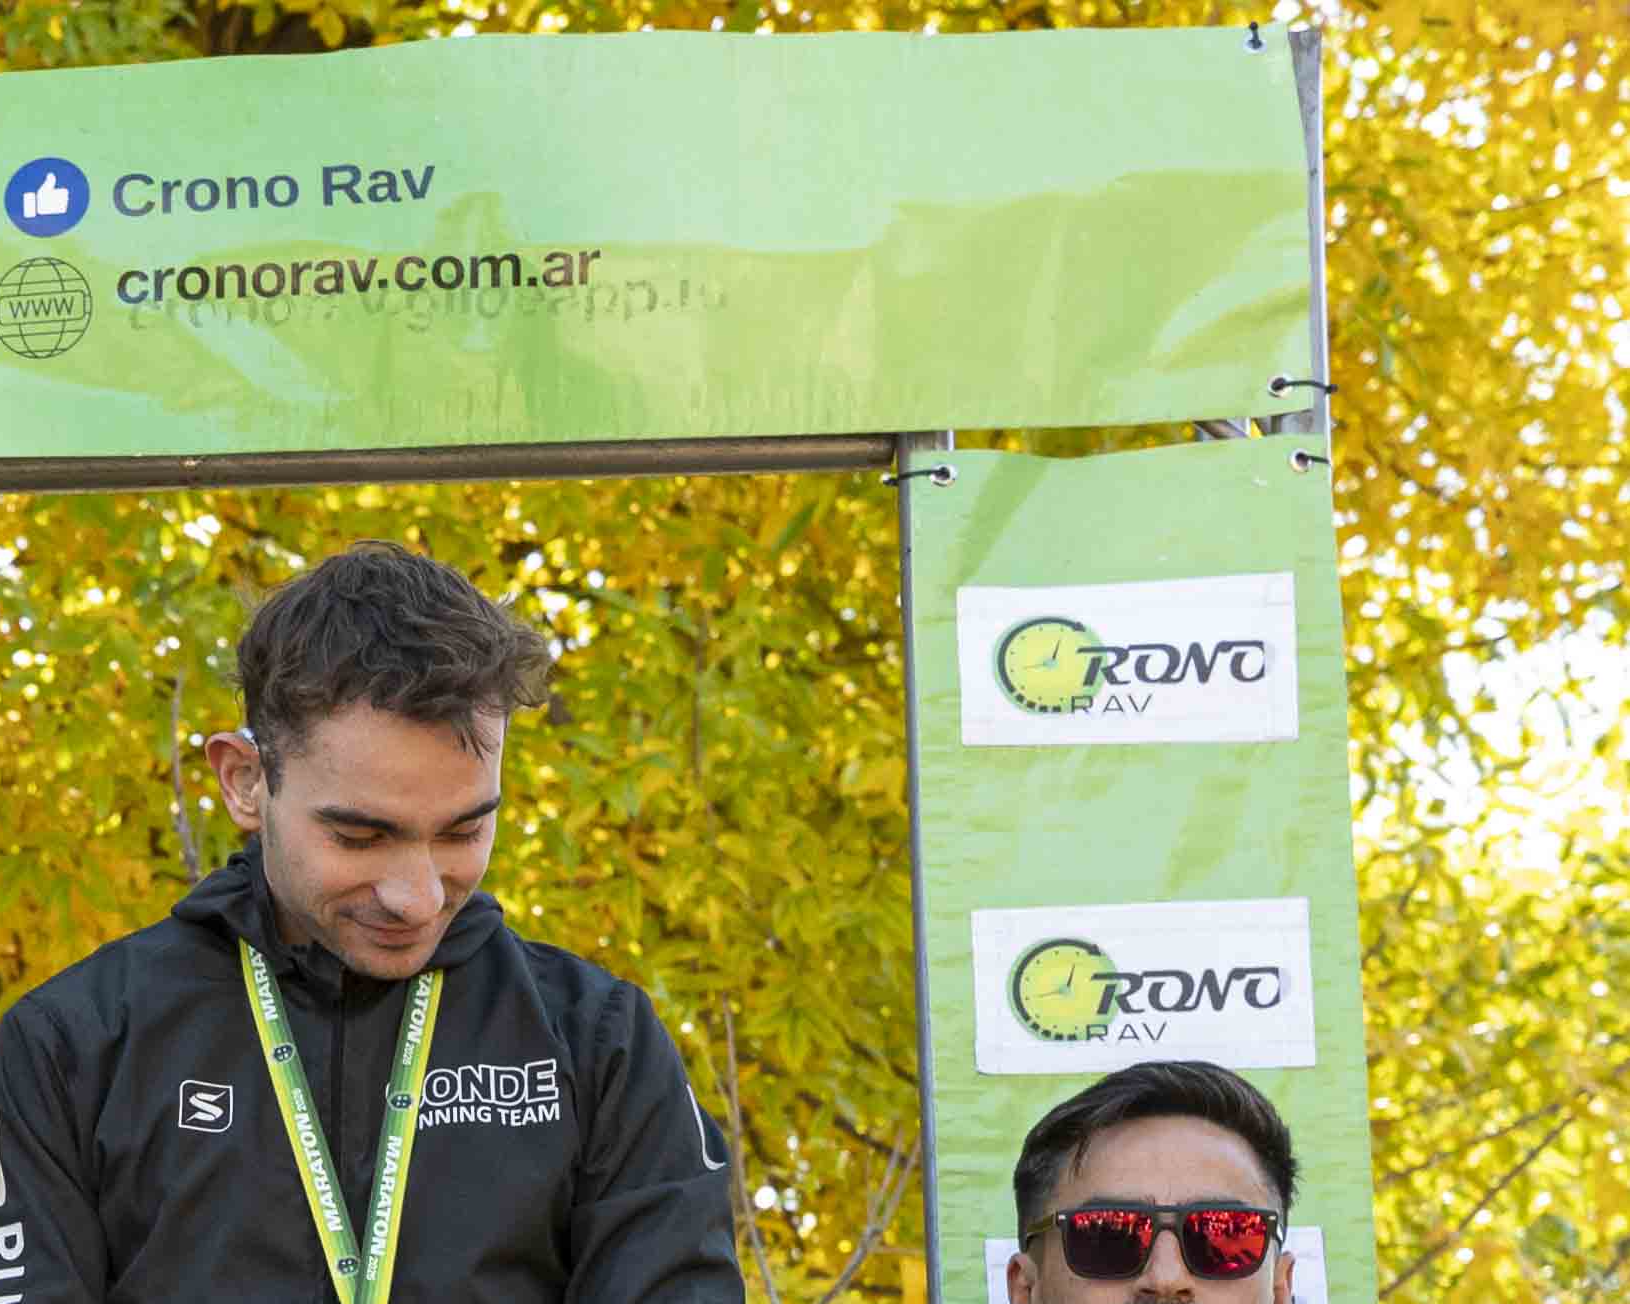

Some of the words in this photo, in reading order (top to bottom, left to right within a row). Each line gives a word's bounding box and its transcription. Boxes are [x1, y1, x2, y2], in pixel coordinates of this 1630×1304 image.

[113, 173, 300, 218] Crono
[322, 161, 436, 205] Rav
[117, 245, 602, 304] cronorav.com.ar
[1071, 694, 1152, 712] RAV
[1086, 1022, 1167, 1041] RAV
[419, 1059, 559, 1109] ONDE
[419, 1106, 492, 1131] NNING
[499, 1102, 560, 1126] TEAM
[293, 1112, 344, 1232] MARATON
[371, 1135, 403, 1257] MARATON
